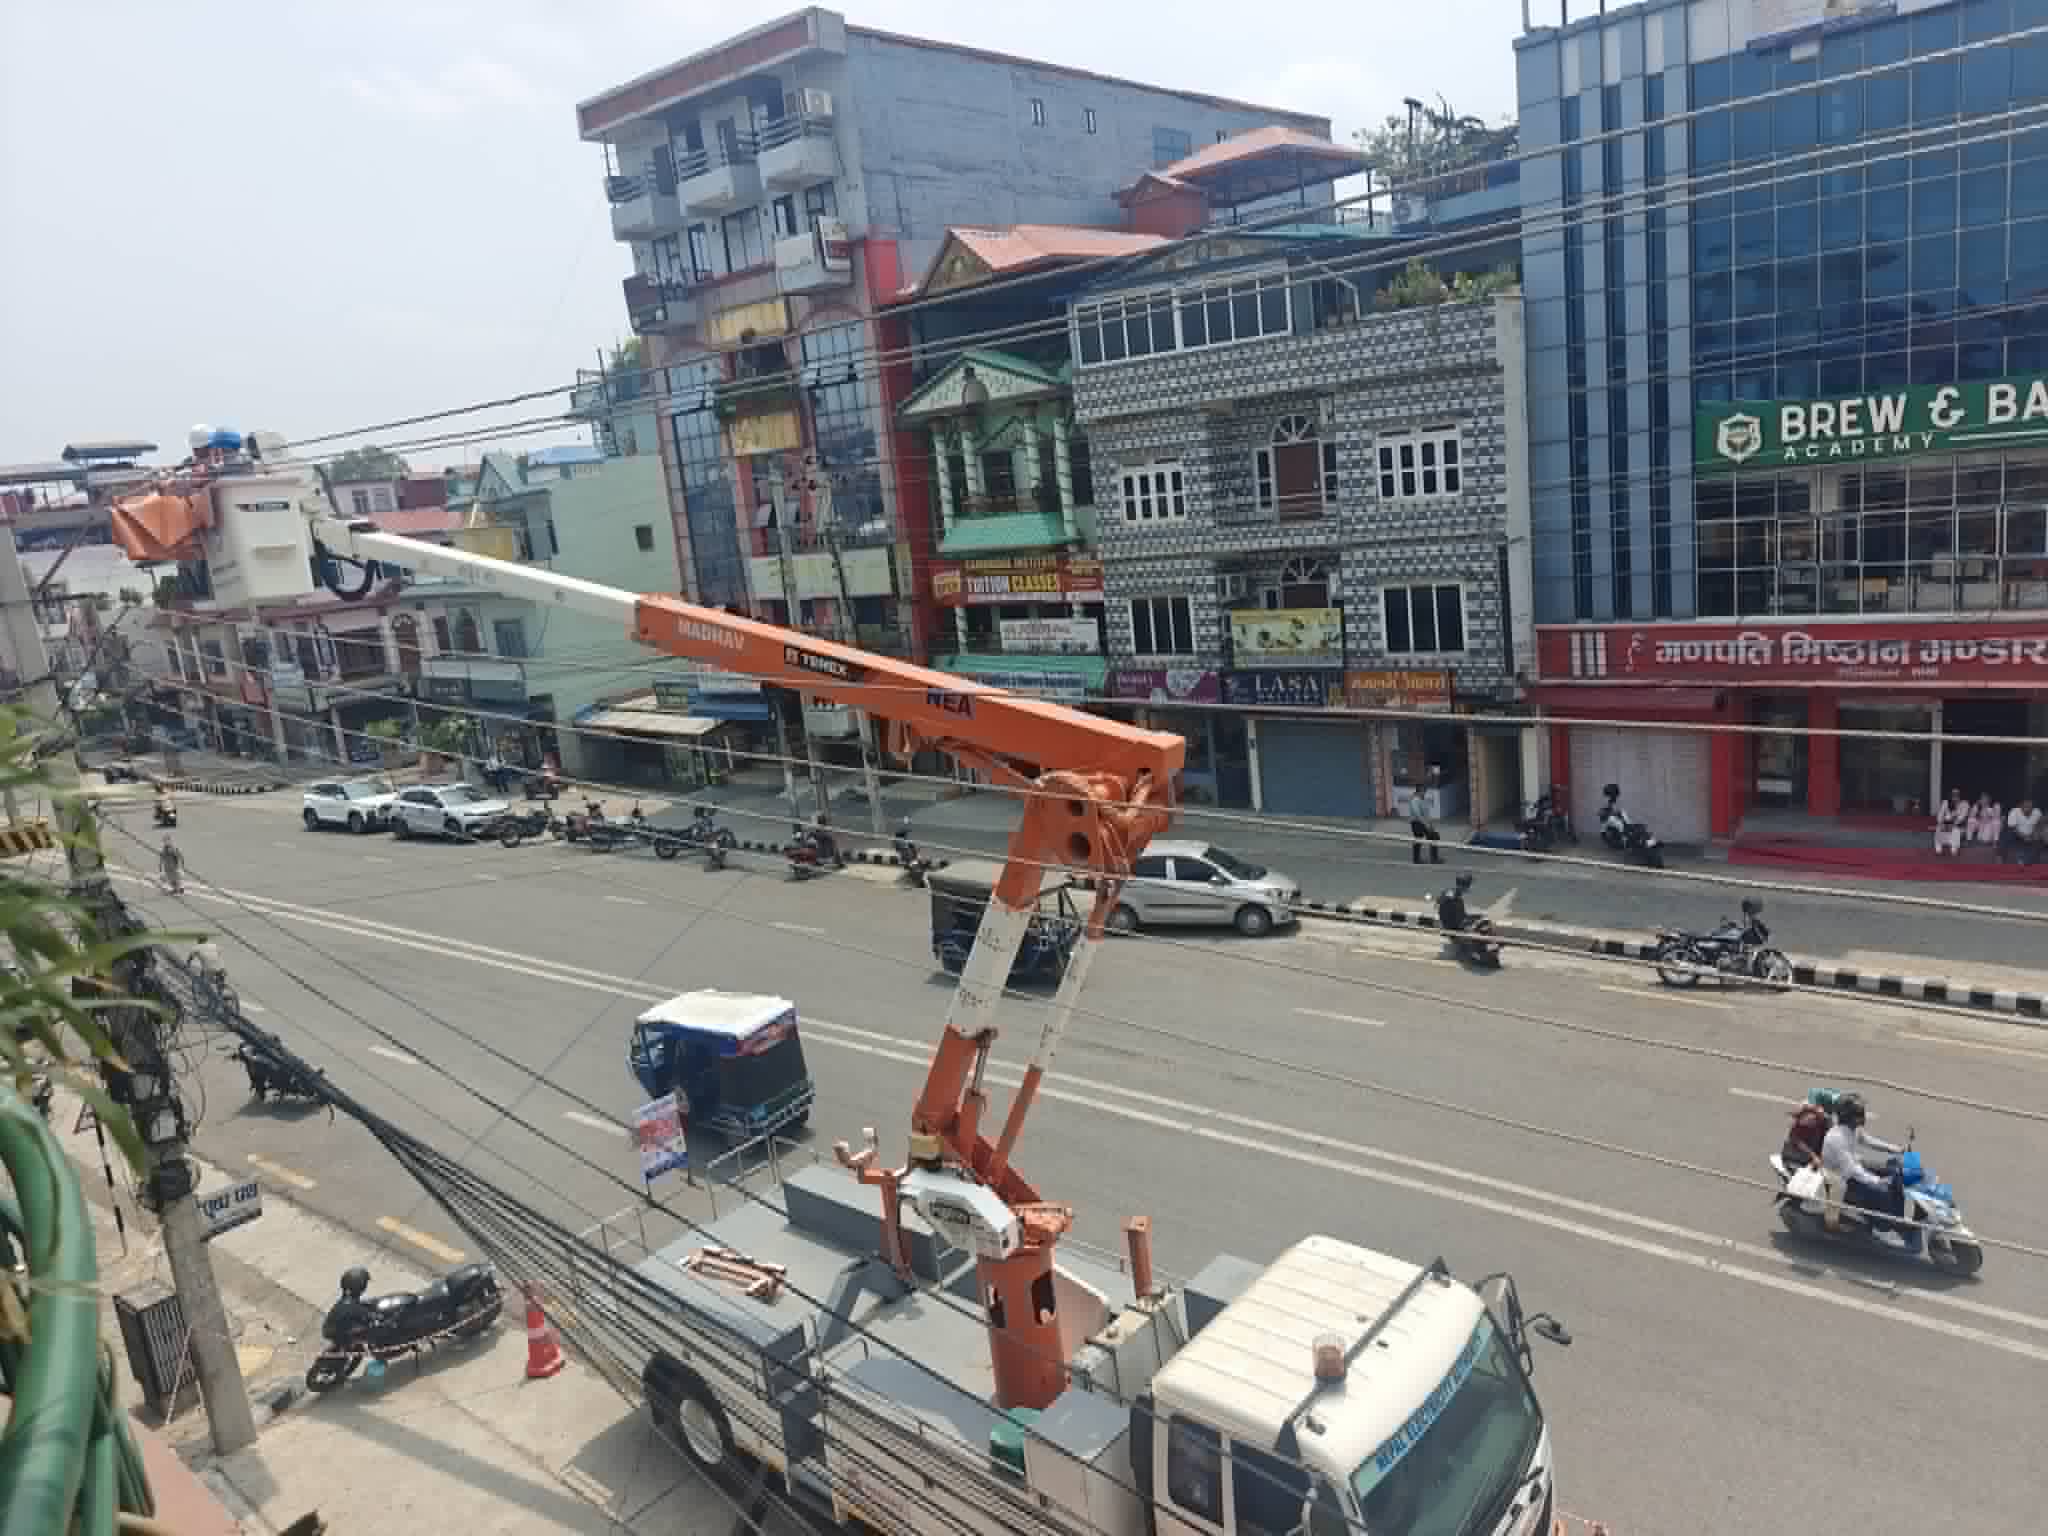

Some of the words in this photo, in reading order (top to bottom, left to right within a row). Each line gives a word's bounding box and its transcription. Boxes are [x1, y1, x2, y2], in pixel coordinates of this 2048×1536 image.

[1781, 394, 1907, 442] BREW
[1928, 385, 1966, 428] &
[1783, 431, 1935, 461] ACADEMY
